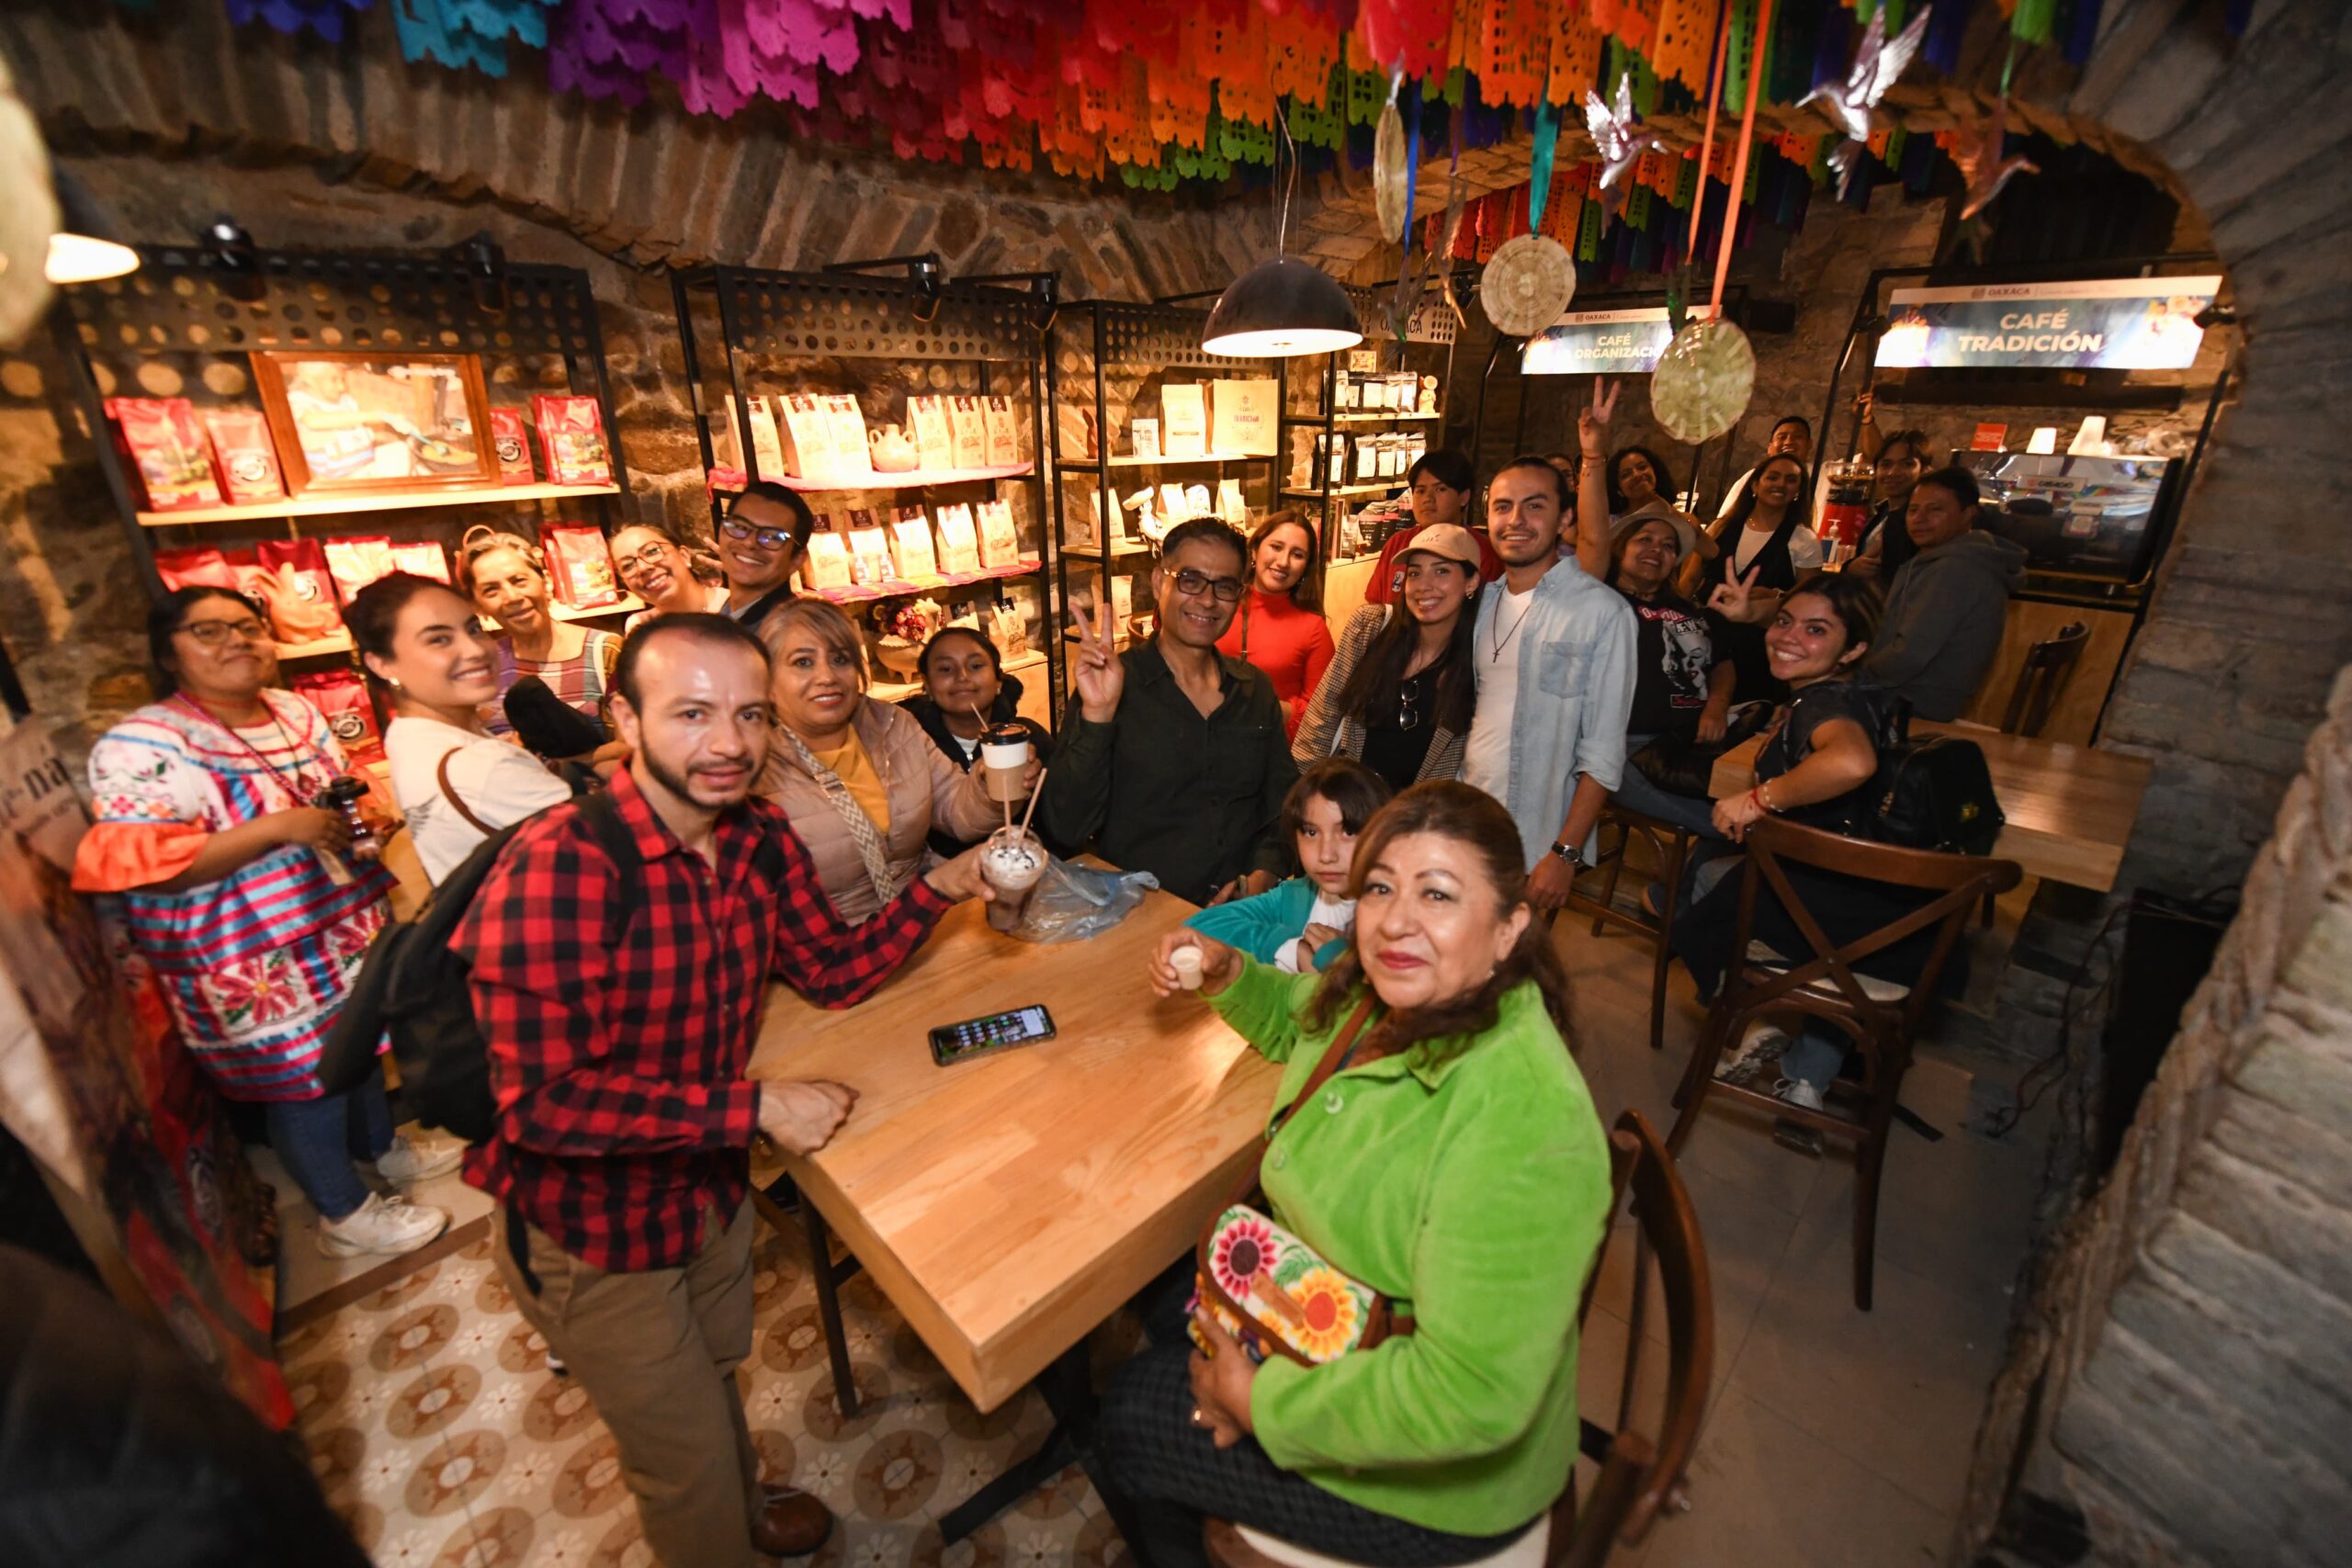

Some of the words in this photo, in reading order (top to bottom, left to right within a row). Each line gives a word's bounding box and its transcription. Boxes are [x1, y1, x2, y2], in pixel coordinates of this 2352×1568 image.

[1987, 287, 2031, 297] OAXACA
[1999, 309, 2069, 331] CAFÉ
[1597, 332, 1632, 346] CAFÉ
[1958, 330, 2103, 353] TRADICIÓN
